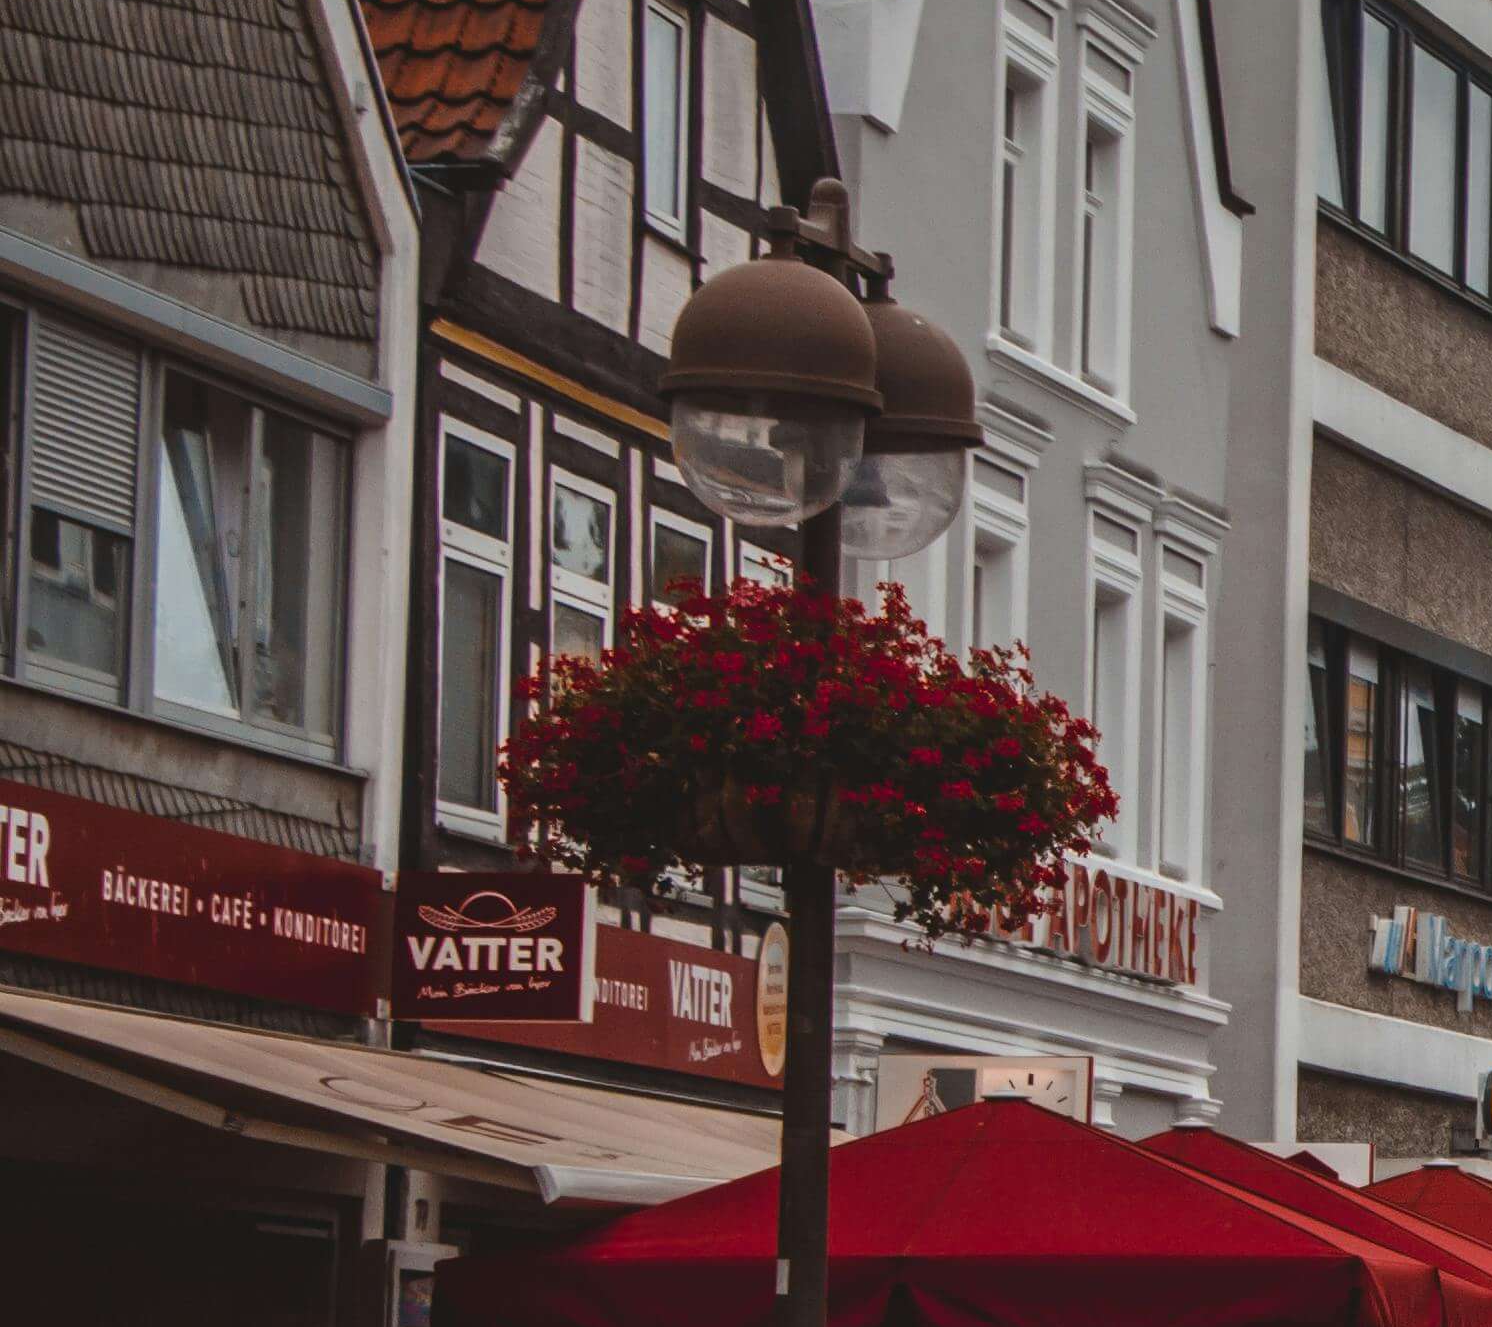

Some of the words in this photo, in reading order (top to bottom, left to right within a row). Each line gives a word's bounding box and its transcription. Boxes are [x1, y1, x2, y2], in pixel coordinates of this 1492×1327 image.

[102, 865, 190, 917] BÄCKEREI
[211, 891, 252, 930] CAFÉ
[273, 906, 367, 955] KONDITOREI
[1048, 864, 1198, 986] APOTHEKE
[407, 936, 564, 972] VATTER
[669, 959, 733, 1028] VATTER
